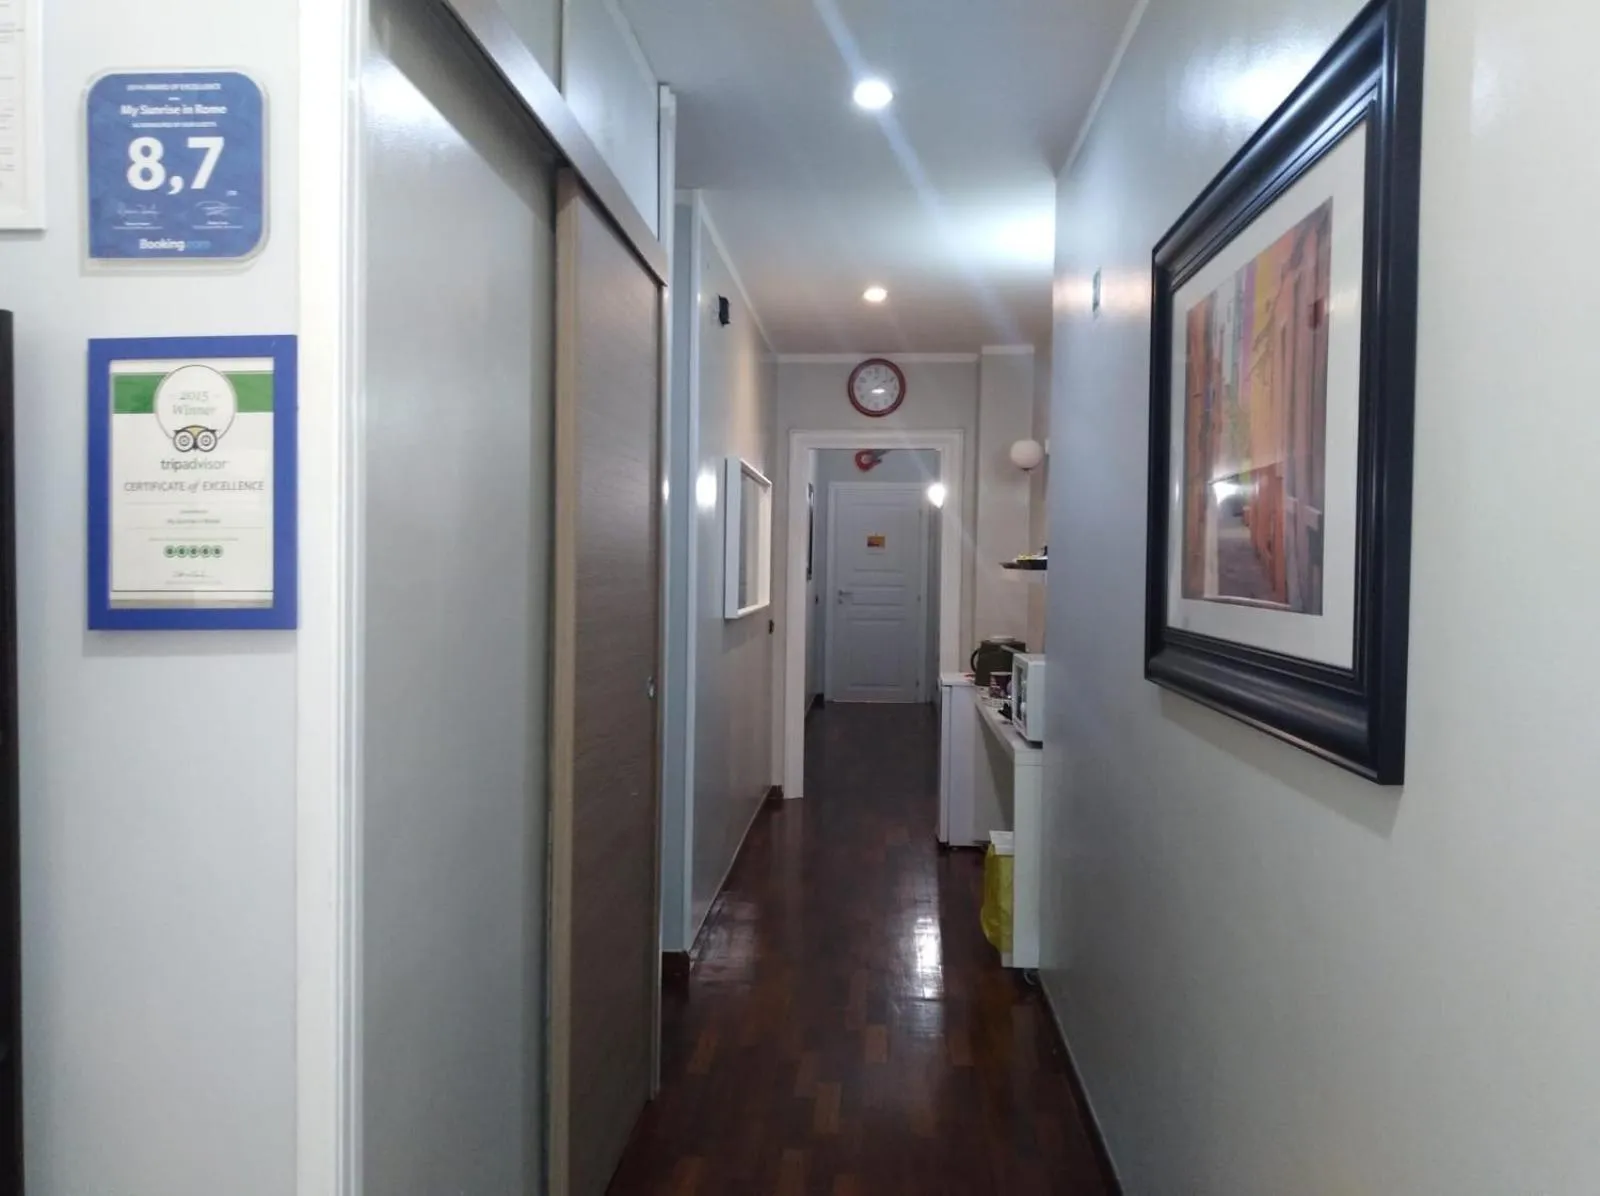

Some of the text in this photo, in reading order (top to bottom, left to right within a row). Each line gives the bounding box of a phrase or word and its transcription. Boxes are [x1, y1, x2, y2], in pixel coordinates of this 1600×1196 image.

[121, 104, 227, 117] My Sunrise in Rome
[126, 136, 225, 195] 8,7
[173, 405, 215, 416] Winner
[160, 458, 226, 472] tripadvisor
[124, 481, 264, 493] CERTIFICATE of EXCELLENCE
